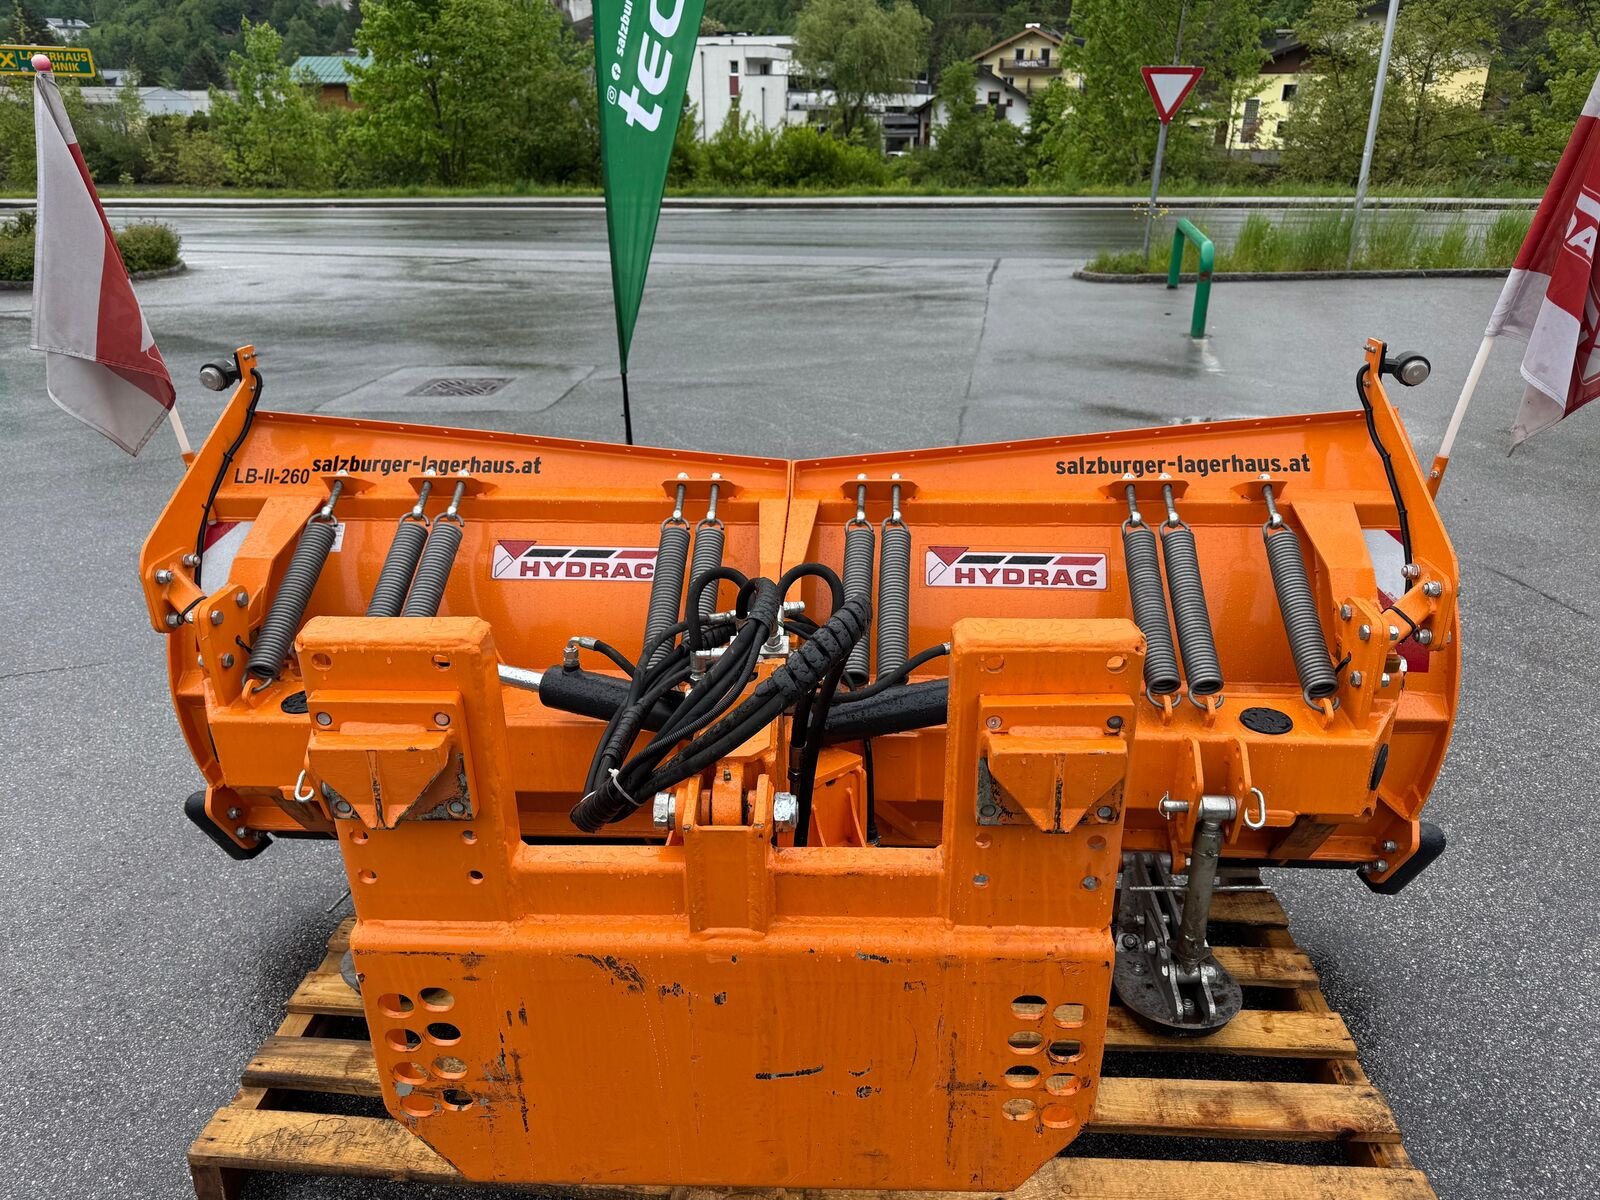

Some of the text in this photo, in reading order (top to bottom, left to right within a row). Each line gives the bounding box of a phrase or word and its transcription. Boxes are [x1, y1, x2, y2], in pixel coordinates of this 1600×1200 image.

[19, 51, 88, 62] LARHAUS
[52, 61, 80, 71] HNIK
[312, 455, 542, 476] salzburger-lagerhaus.at
[1055, 454, 1311, 477] salzburger-lagerhaus.at
[519, 561, 654, 579] HYDRAC
[954, 567, 1098, 587] HYDRAC
